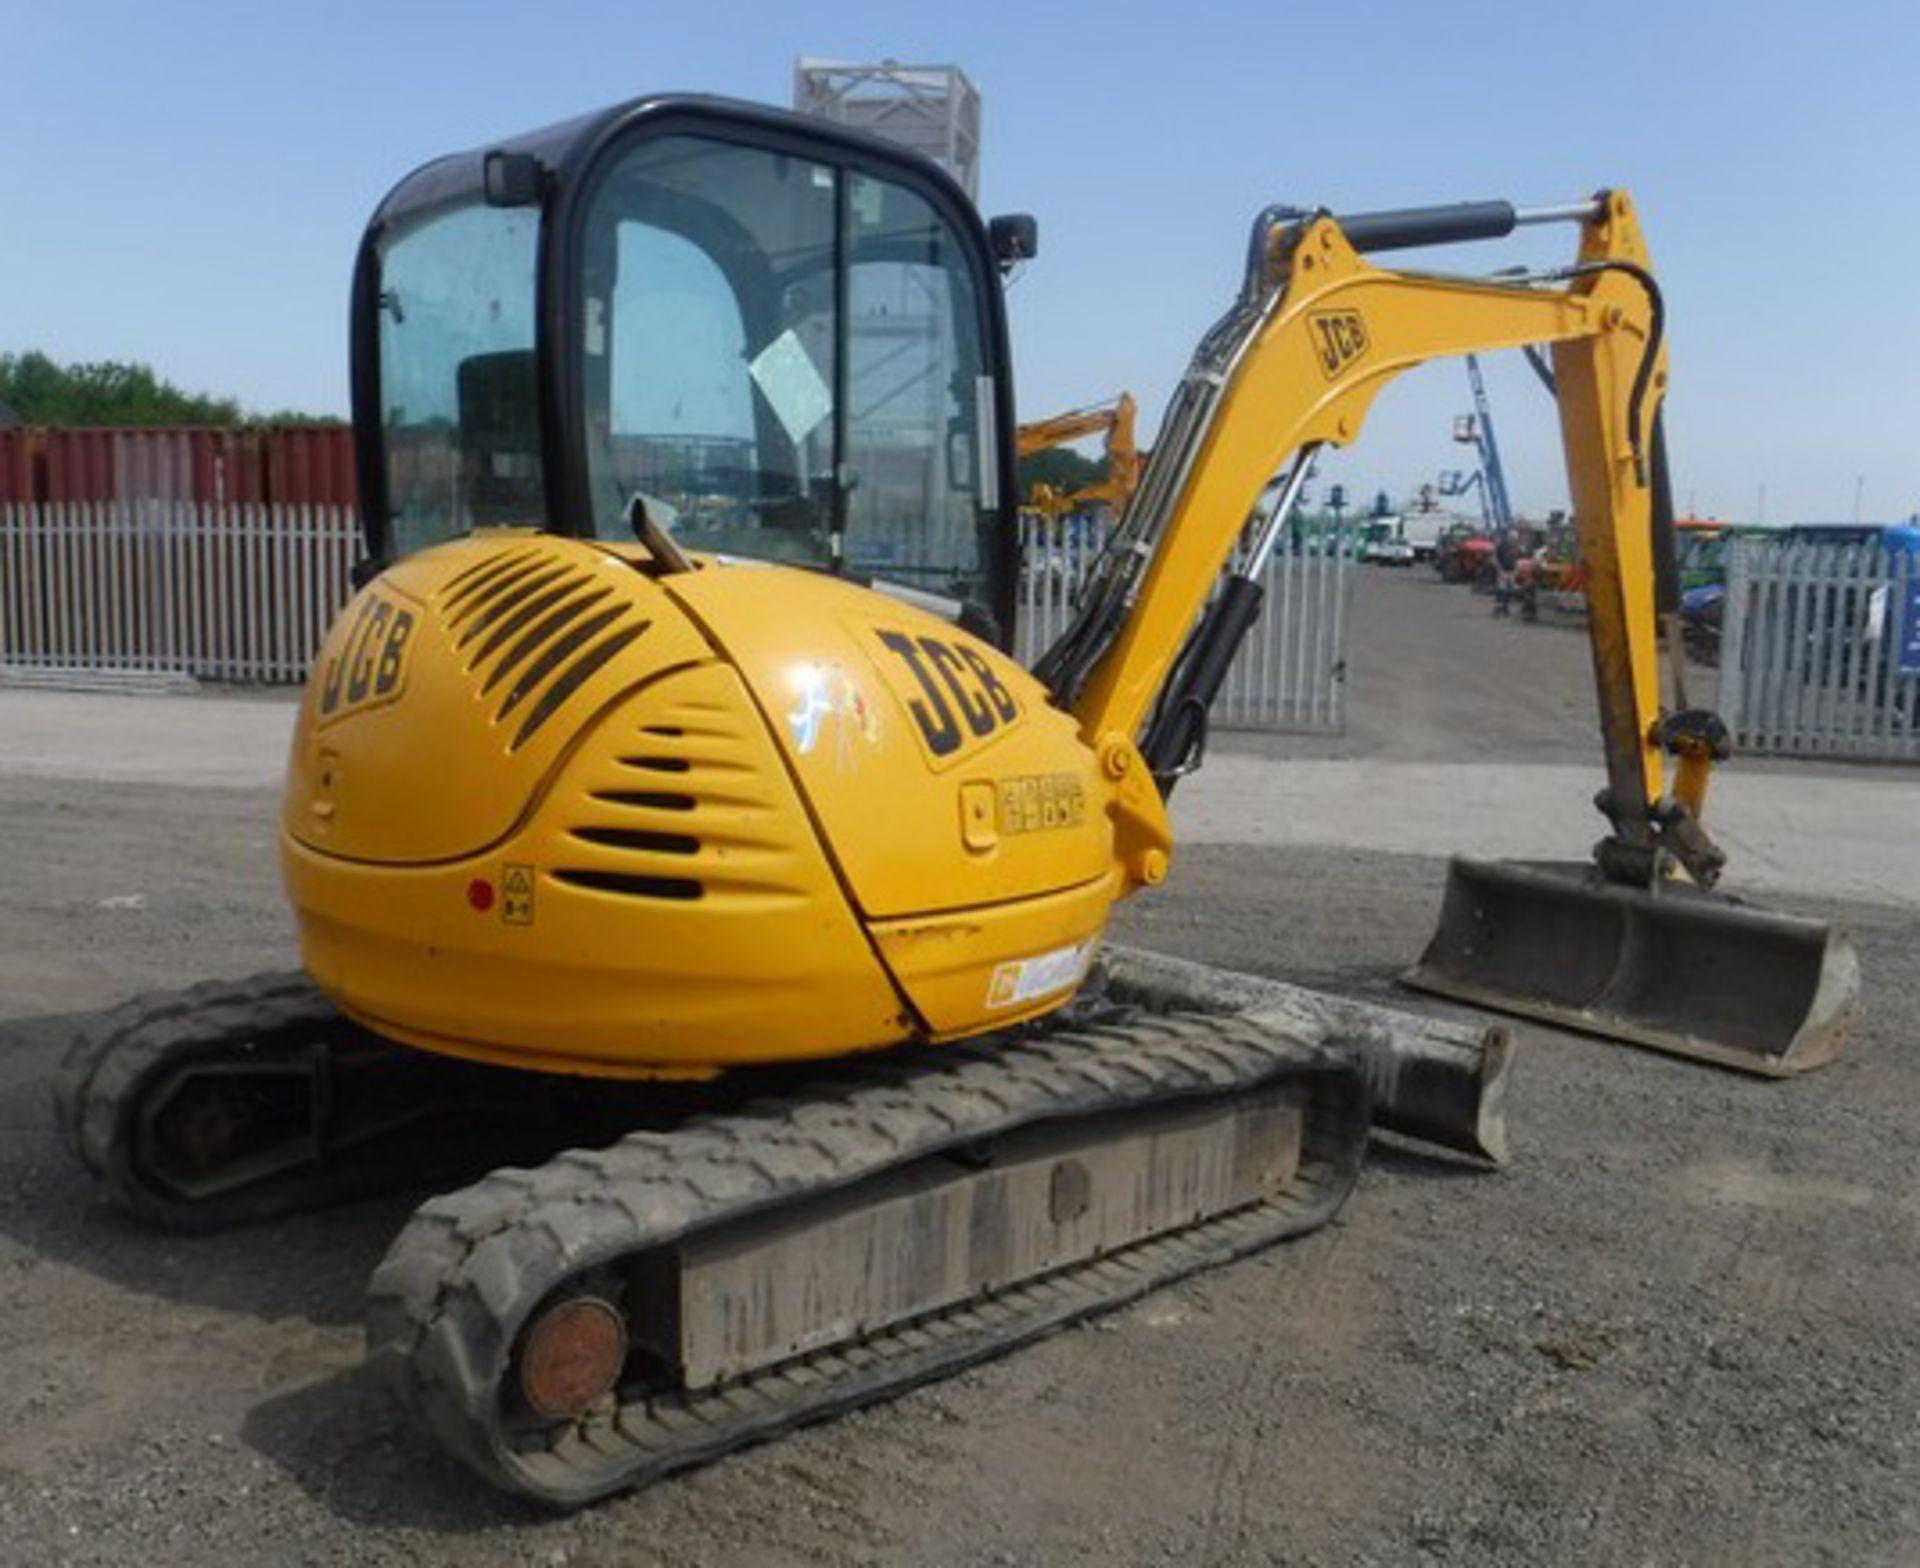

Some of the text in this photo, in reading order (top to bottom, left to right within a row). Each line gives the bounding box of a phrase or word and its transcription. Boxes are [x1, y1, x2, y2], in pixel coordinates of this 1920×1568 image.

[1316, 316, 1364, 371] JCB
[322, 594, 414, 714] JCB
[875, 631, 1016, 756] JCB
